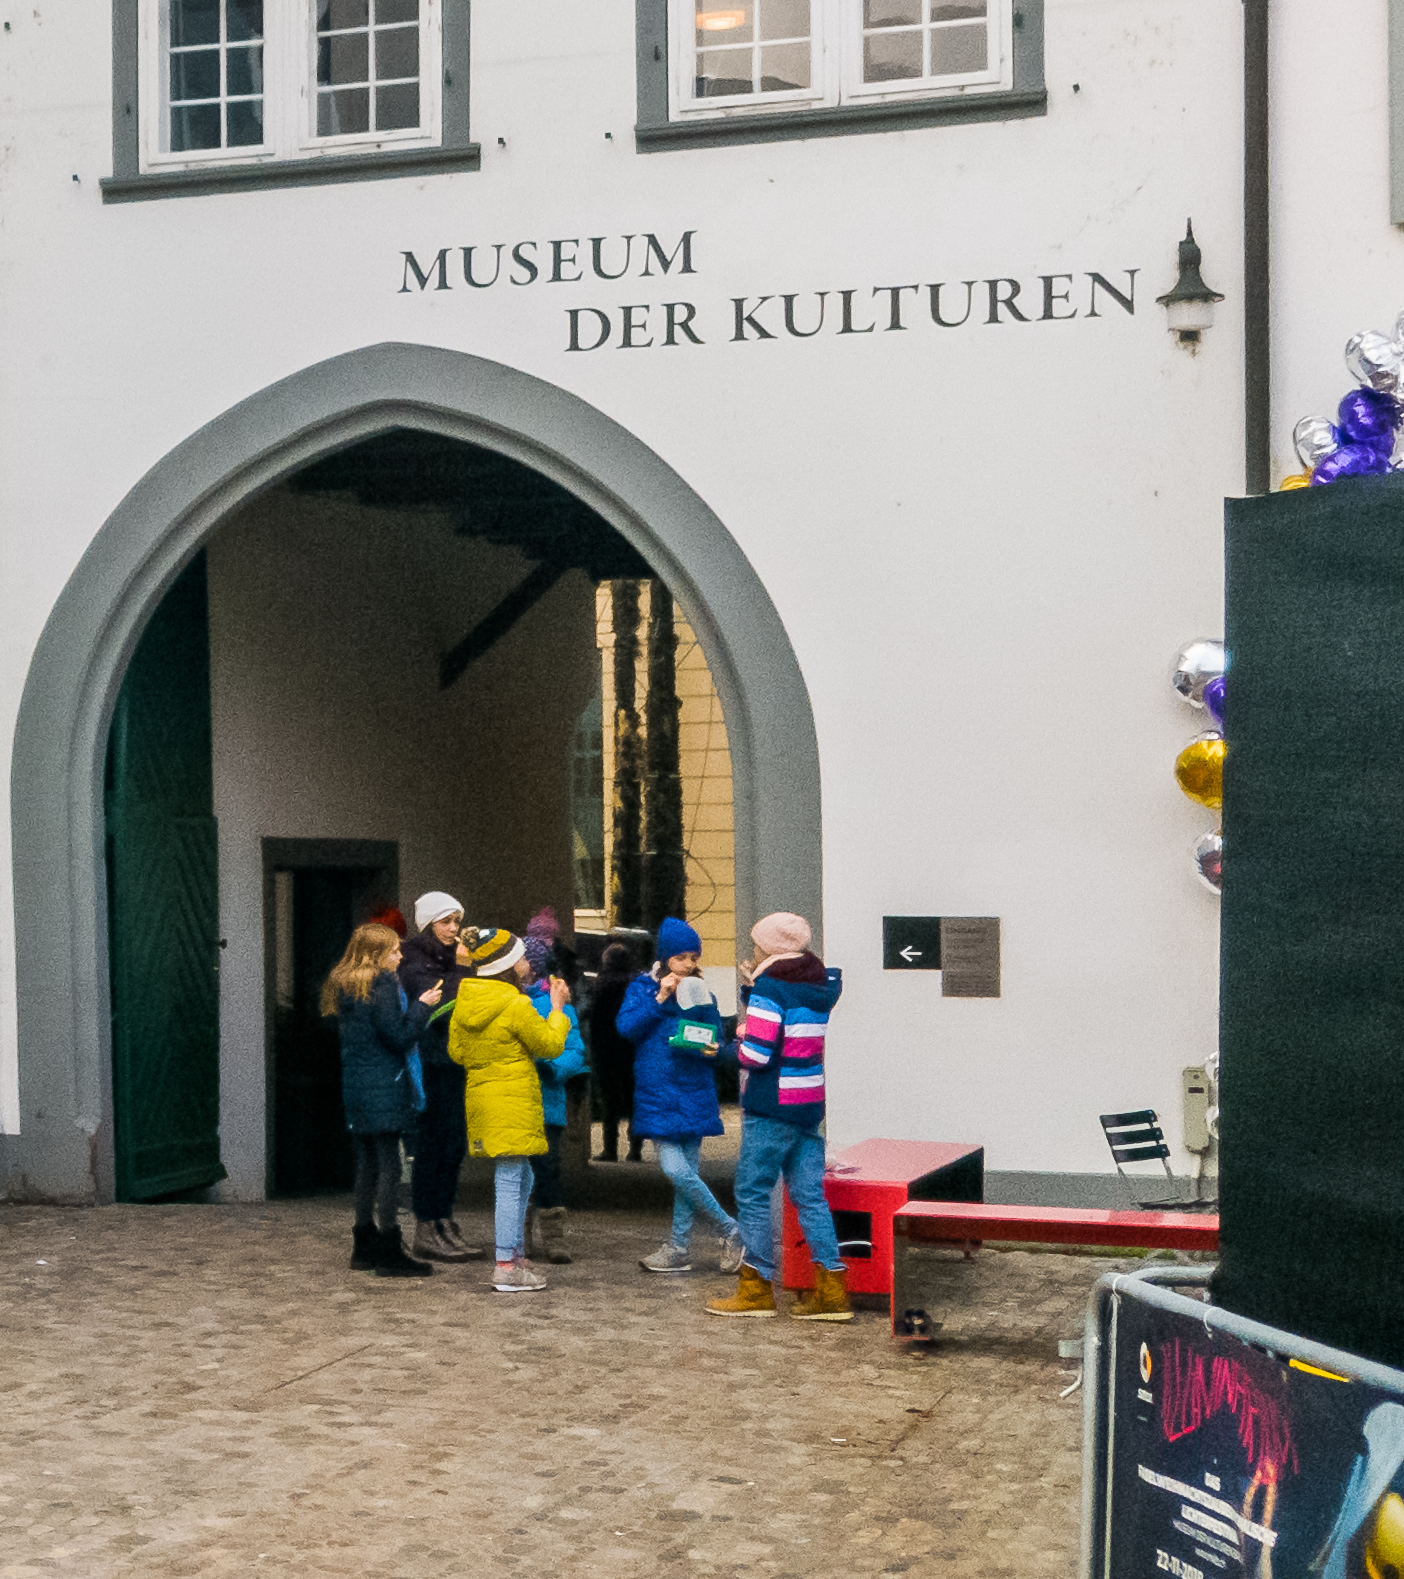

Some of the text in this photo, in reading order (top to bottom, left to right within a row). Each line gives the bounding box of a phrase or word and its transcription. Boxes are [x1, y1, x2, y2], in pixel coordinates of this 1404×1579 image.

[396, 229, 699, 294] MUSEUM
[563, 267, 1142, 353] DER KULTUREN
